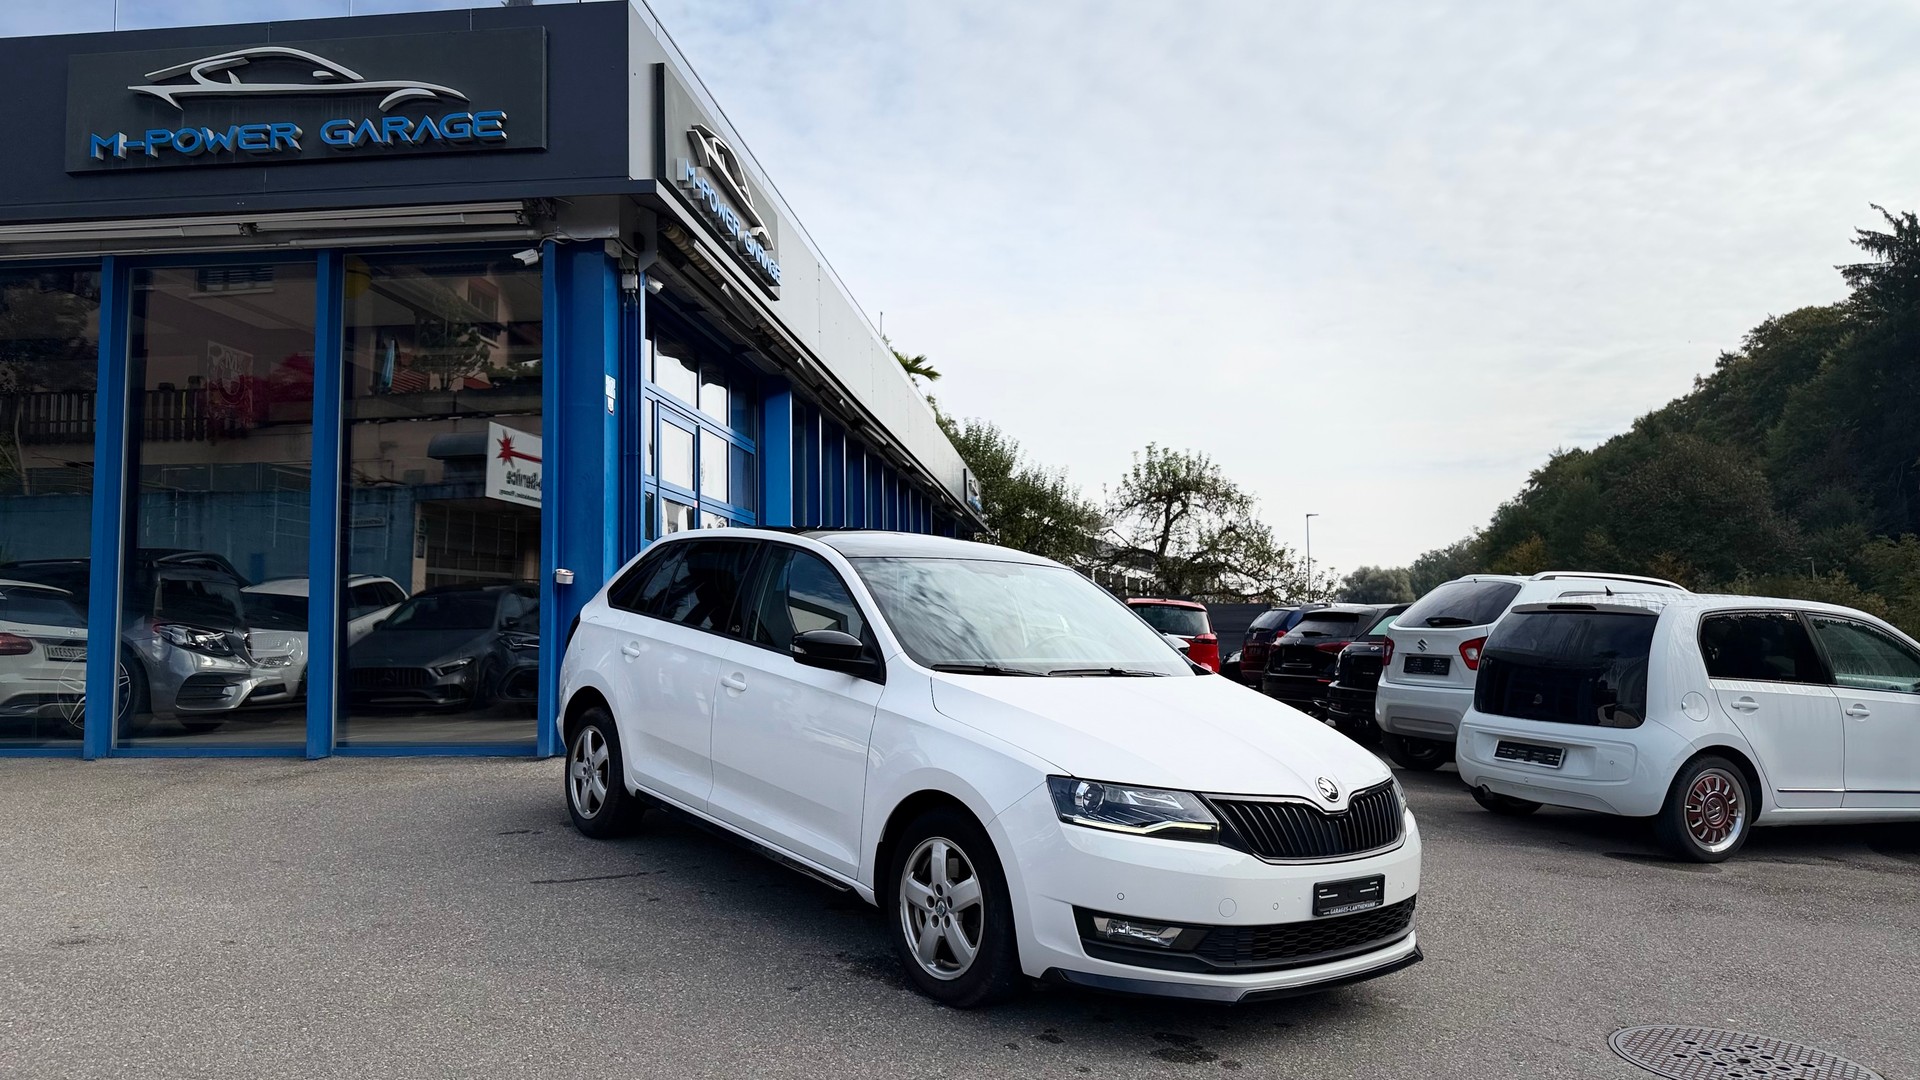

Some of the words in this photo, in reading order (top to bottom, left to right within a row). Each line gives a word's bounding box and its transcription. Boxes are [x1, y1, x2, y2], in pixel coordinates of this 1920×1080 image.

[90, 122, 302, 161] M-POWER
[320, 109, 507, 147] GARAGE
[684, 159, 741, 241] M-POWER
[743, 230, 782, 283] GARAGE
